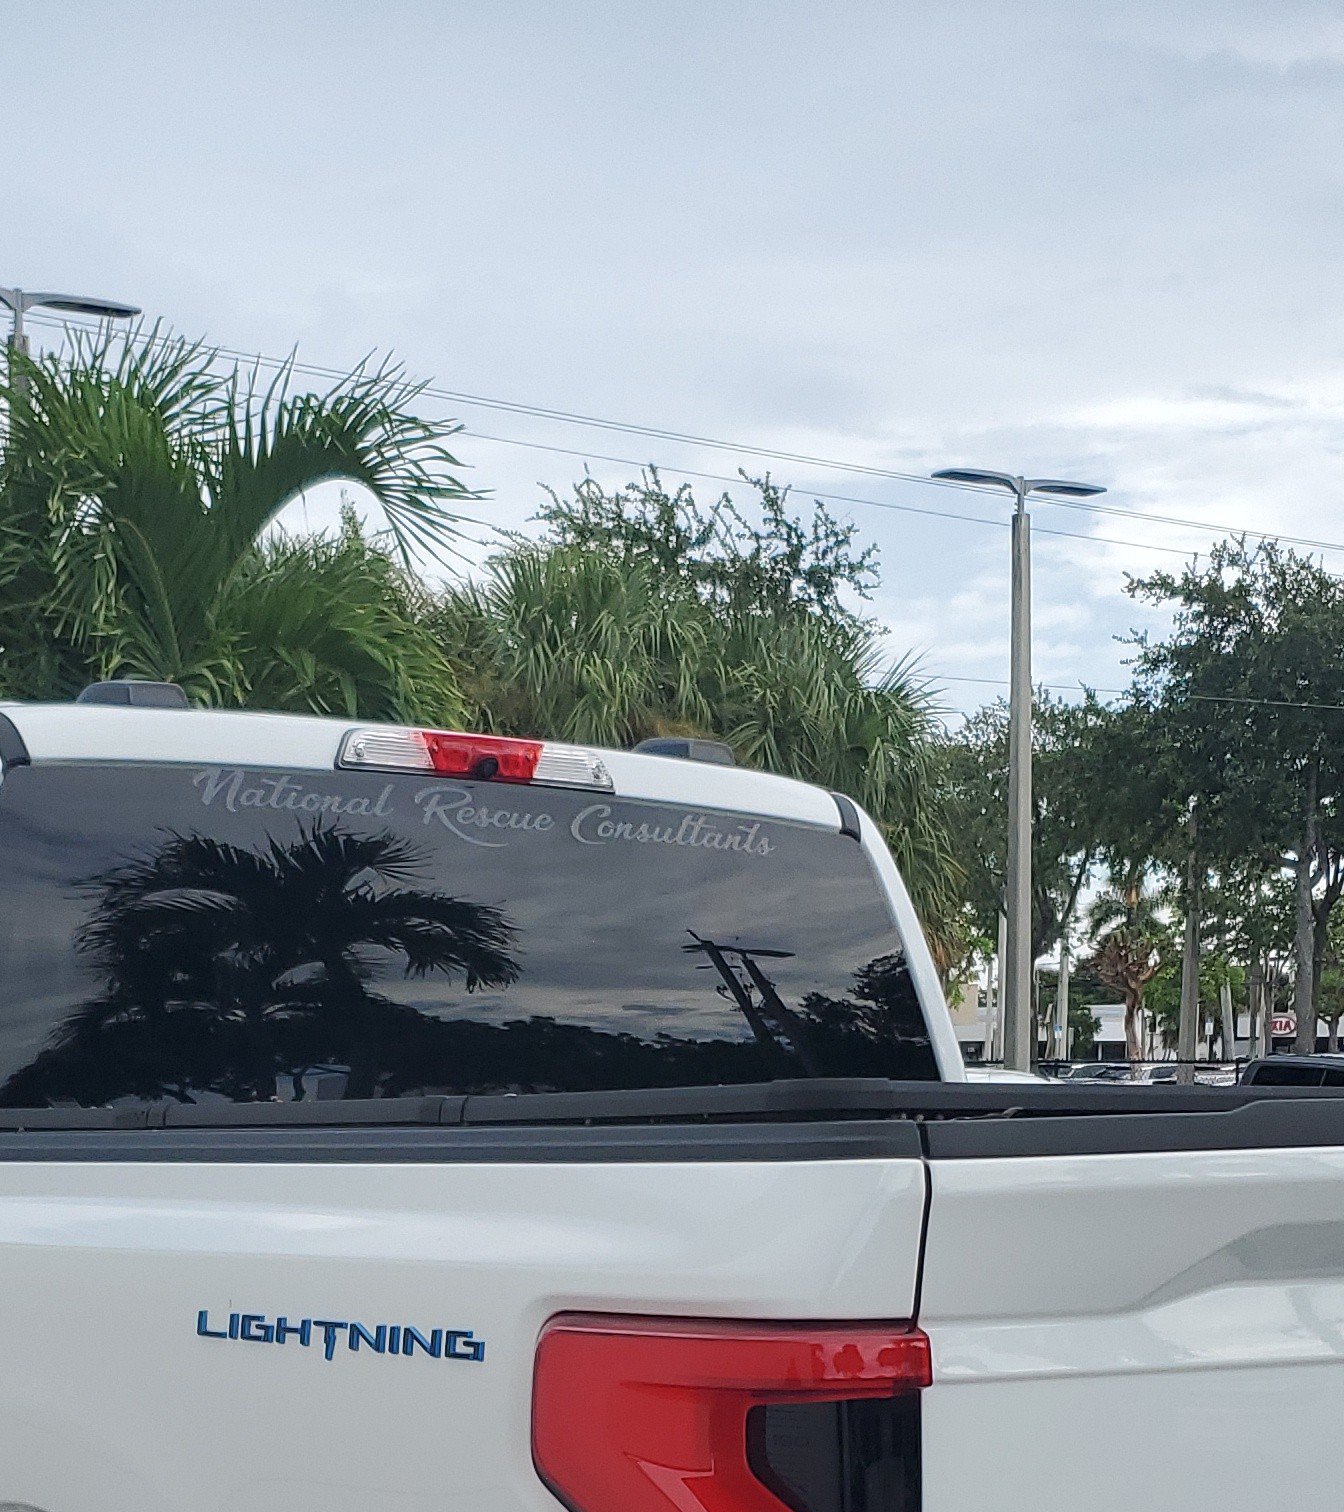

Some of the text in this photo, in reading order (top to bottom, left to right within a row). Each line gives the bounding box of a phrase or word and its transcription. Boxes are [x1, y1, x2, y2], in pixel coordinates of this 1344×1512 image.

[192, 767, 776, 857] National Rescue Consultants
[197, 1310, 486, 1361] LIGHTNING
